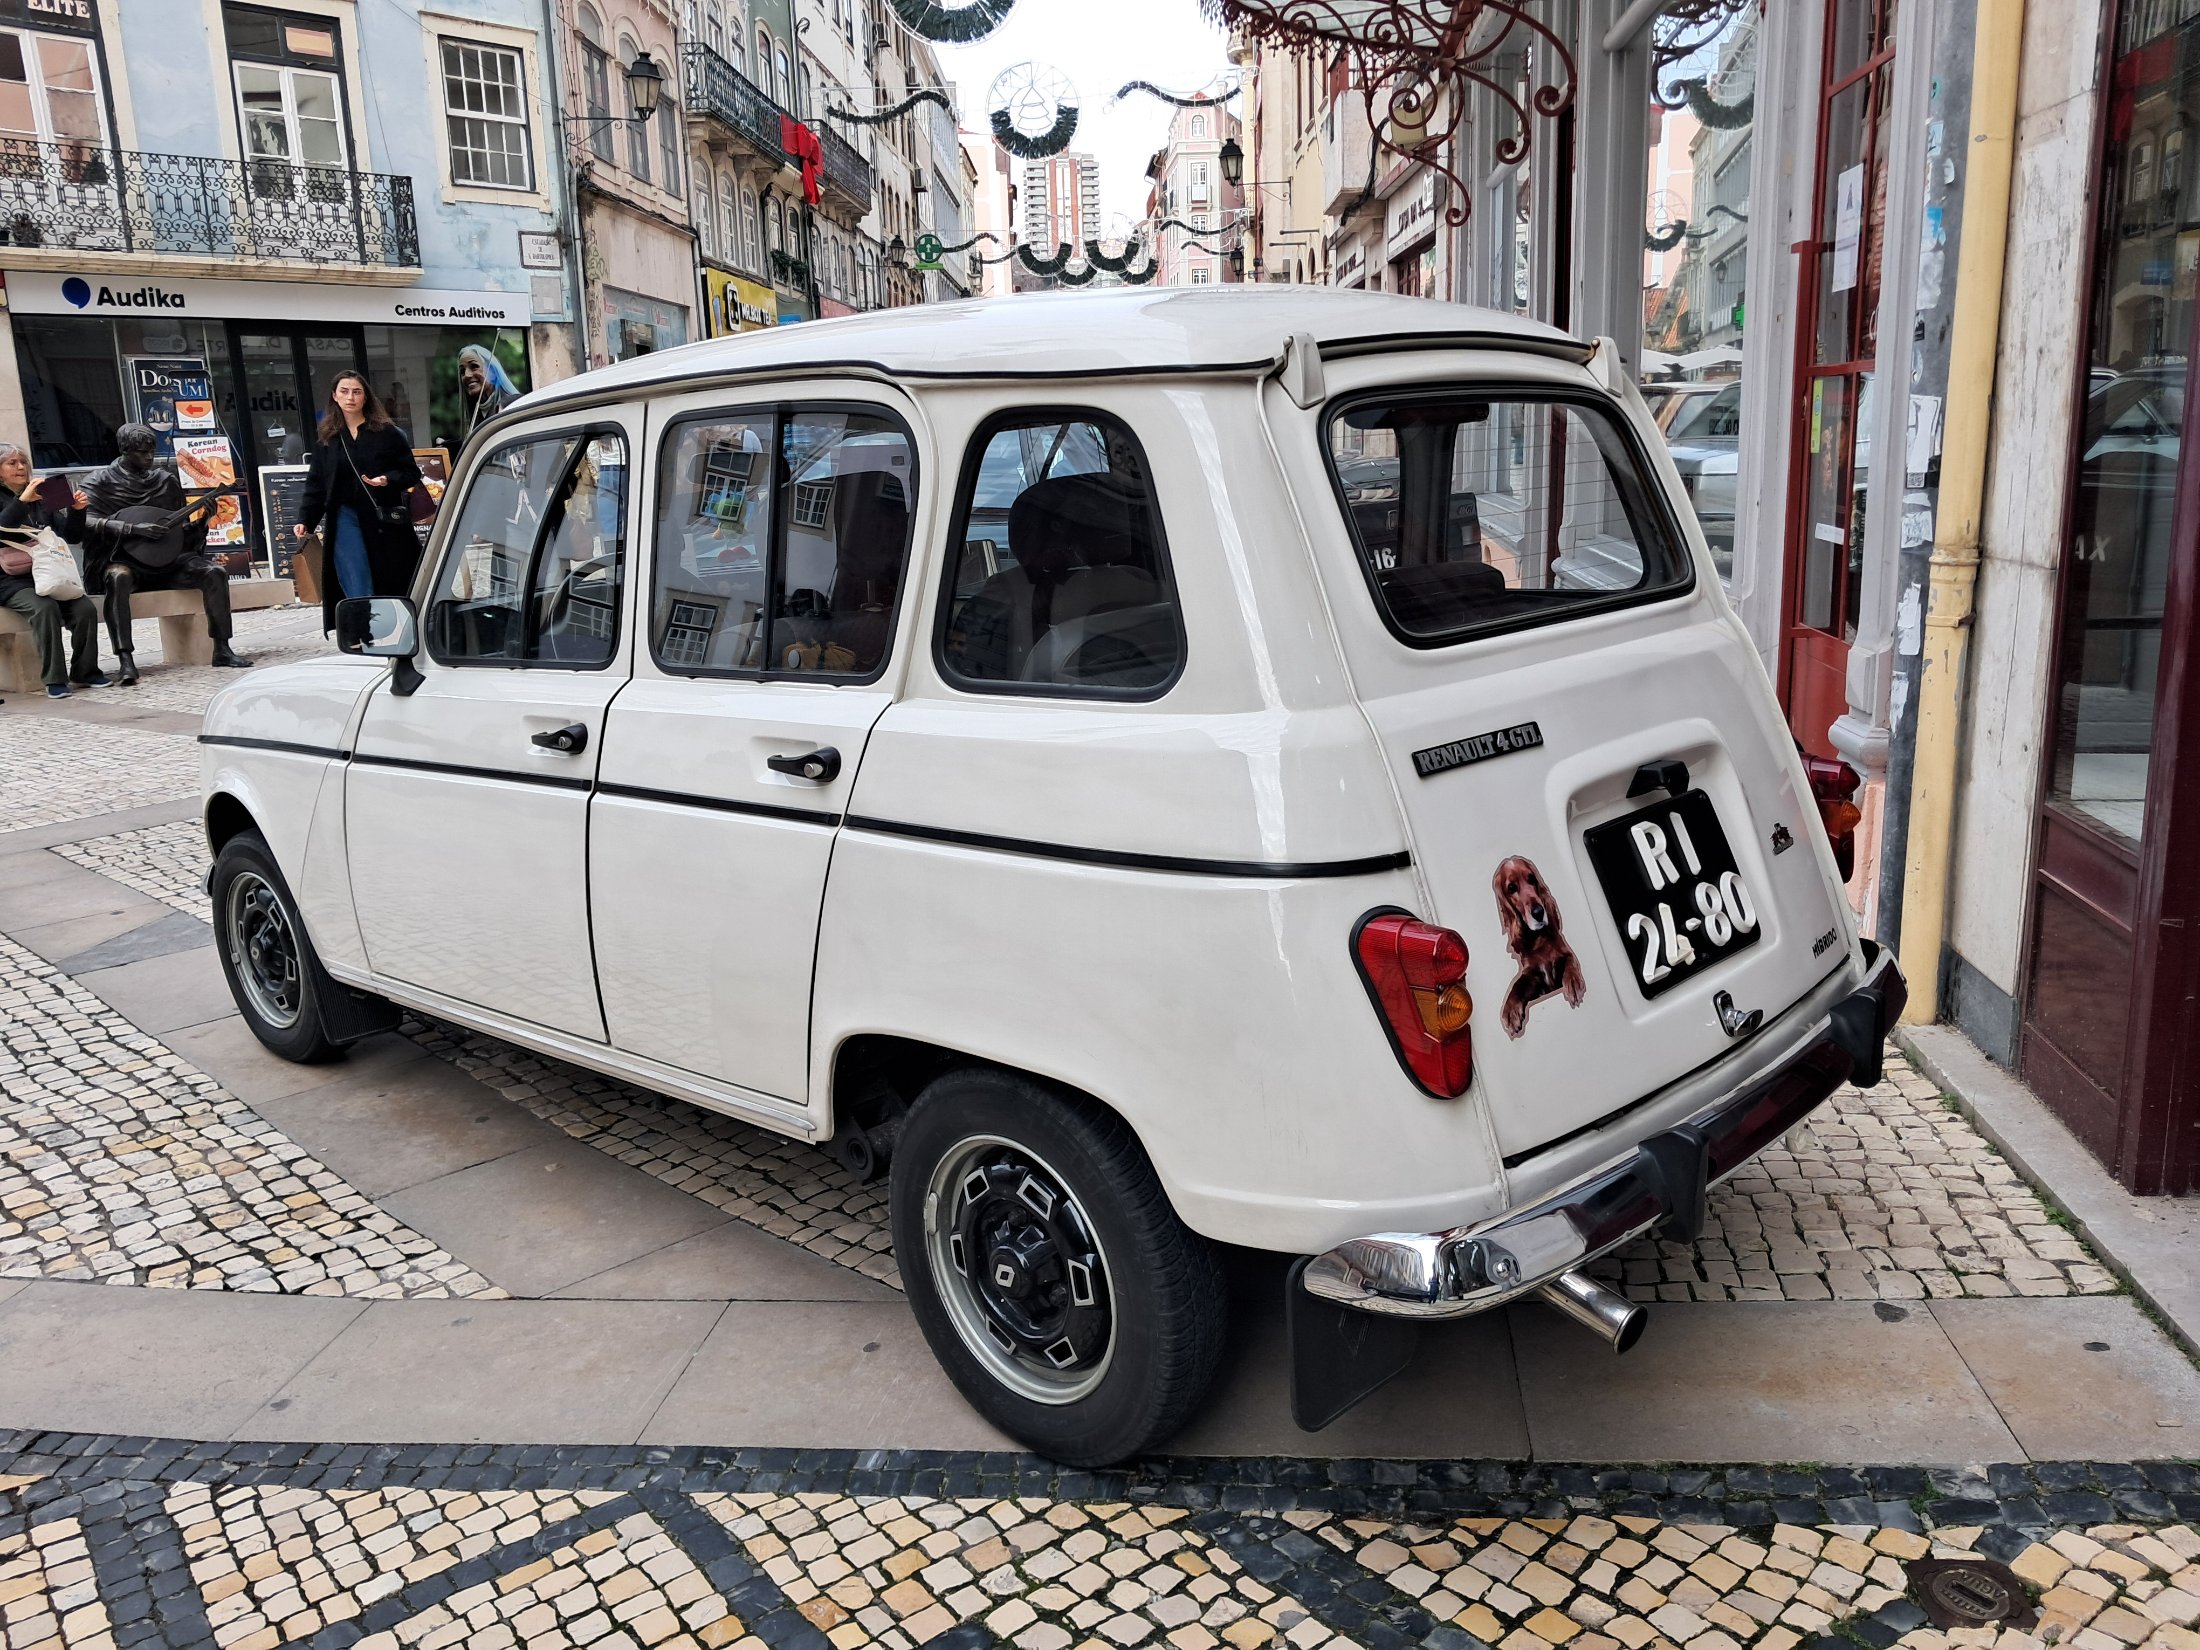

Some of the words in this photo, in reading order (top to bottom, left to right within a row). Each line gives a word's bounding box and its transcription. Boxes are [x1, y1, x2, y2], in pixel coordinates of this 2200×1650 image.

[97, 286, 186, 309] Audika
[394, 304, 446, 318] Centros
[448, 306, 506, 320] Auditivos
[187, 438, 218, 448] Korean
[191, 444, 227, 455] Corndog
[1416, 734, 1497, 773] RENAULT
[1496, 731, 1511, 752] 4
[1508, 724, 1542, 749] GTL
[1630, 811, 1702, 891] RI
[1627, 870, 1757, 985] 24-80
